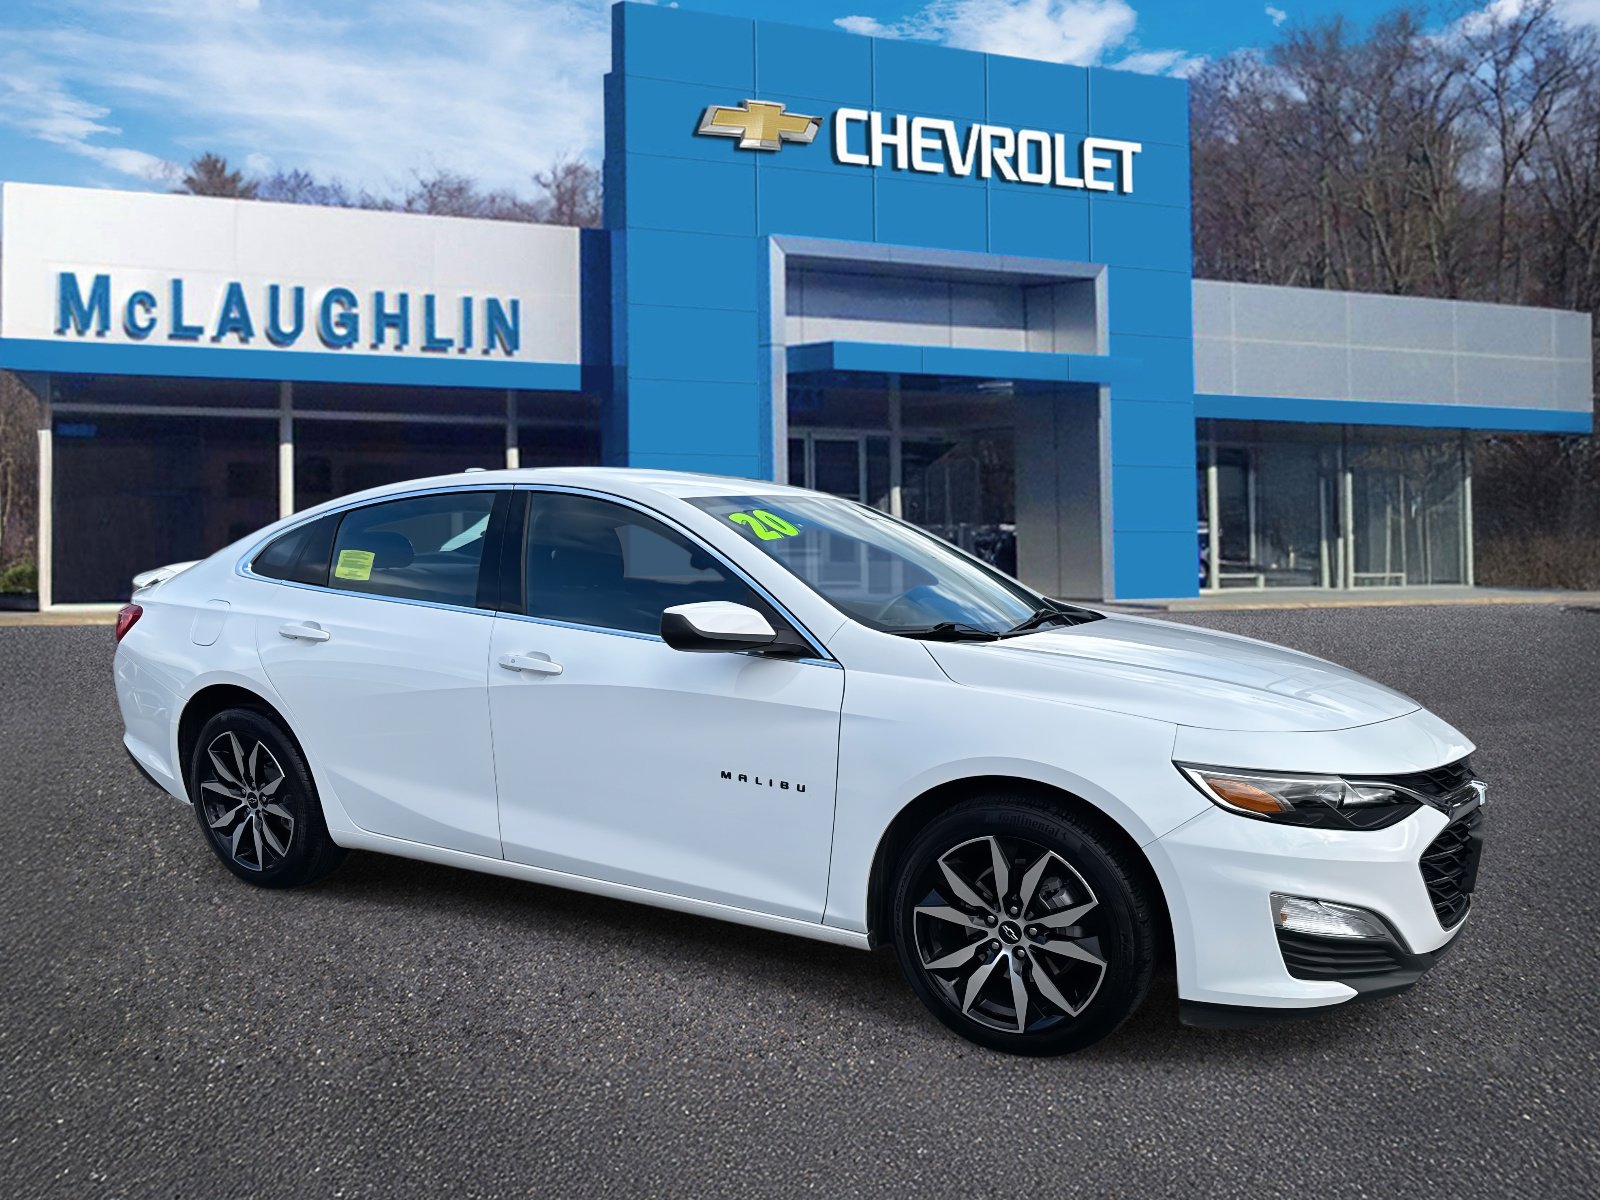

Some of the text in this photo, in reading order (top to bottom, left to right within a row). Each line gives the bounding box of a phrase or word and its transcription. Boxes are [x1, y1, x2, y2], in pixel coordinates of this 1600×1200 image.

[835, 107, 1142, 194] CHEVROLET
[54, 271, 521, 357] McLAUGHLIN
[728, 509, 801, 541] 20
[720, 770, 806, 793] MALIBU
